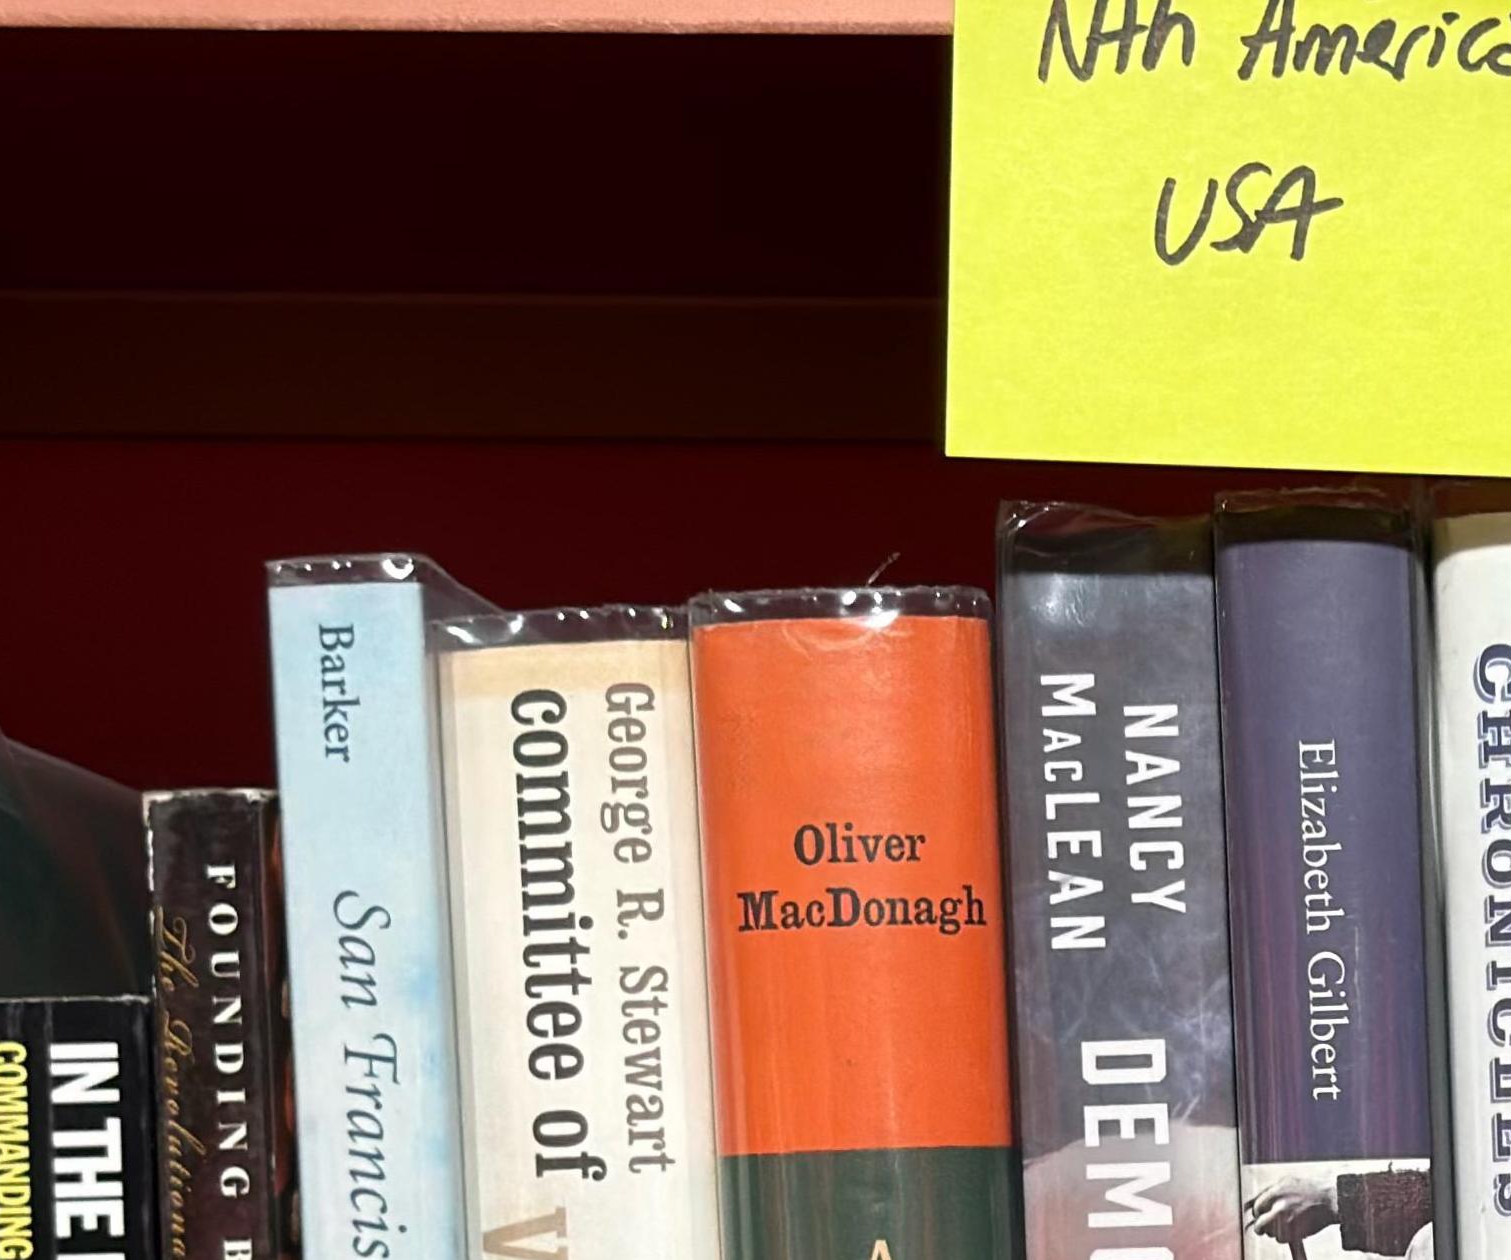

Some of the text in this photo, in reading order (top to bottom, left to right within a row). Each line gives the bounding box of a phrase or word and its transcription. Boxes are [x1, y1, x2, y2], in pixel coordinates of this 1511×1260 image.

[1154, 161, 1344, 266] USA
[318, 623, 362, 764] Barker
[793, 820, 927, 866] Oliver
[1122, 703, 1188, 914] NANCY
[332, 888, 392, 1010] San
[510, 687, 608, 1183] committee of
[599, 681, 677, 1175] George R. Stewart
[736, 884, 988, 936] MacDonagh
[1298, 737, 1352, 1102] Elizabeth Gilbert
[48, 1041, 121, 1105] IN
[205, 864, 251, 1199] FOUNDING
[51, 1117, 125, 1239] THE
